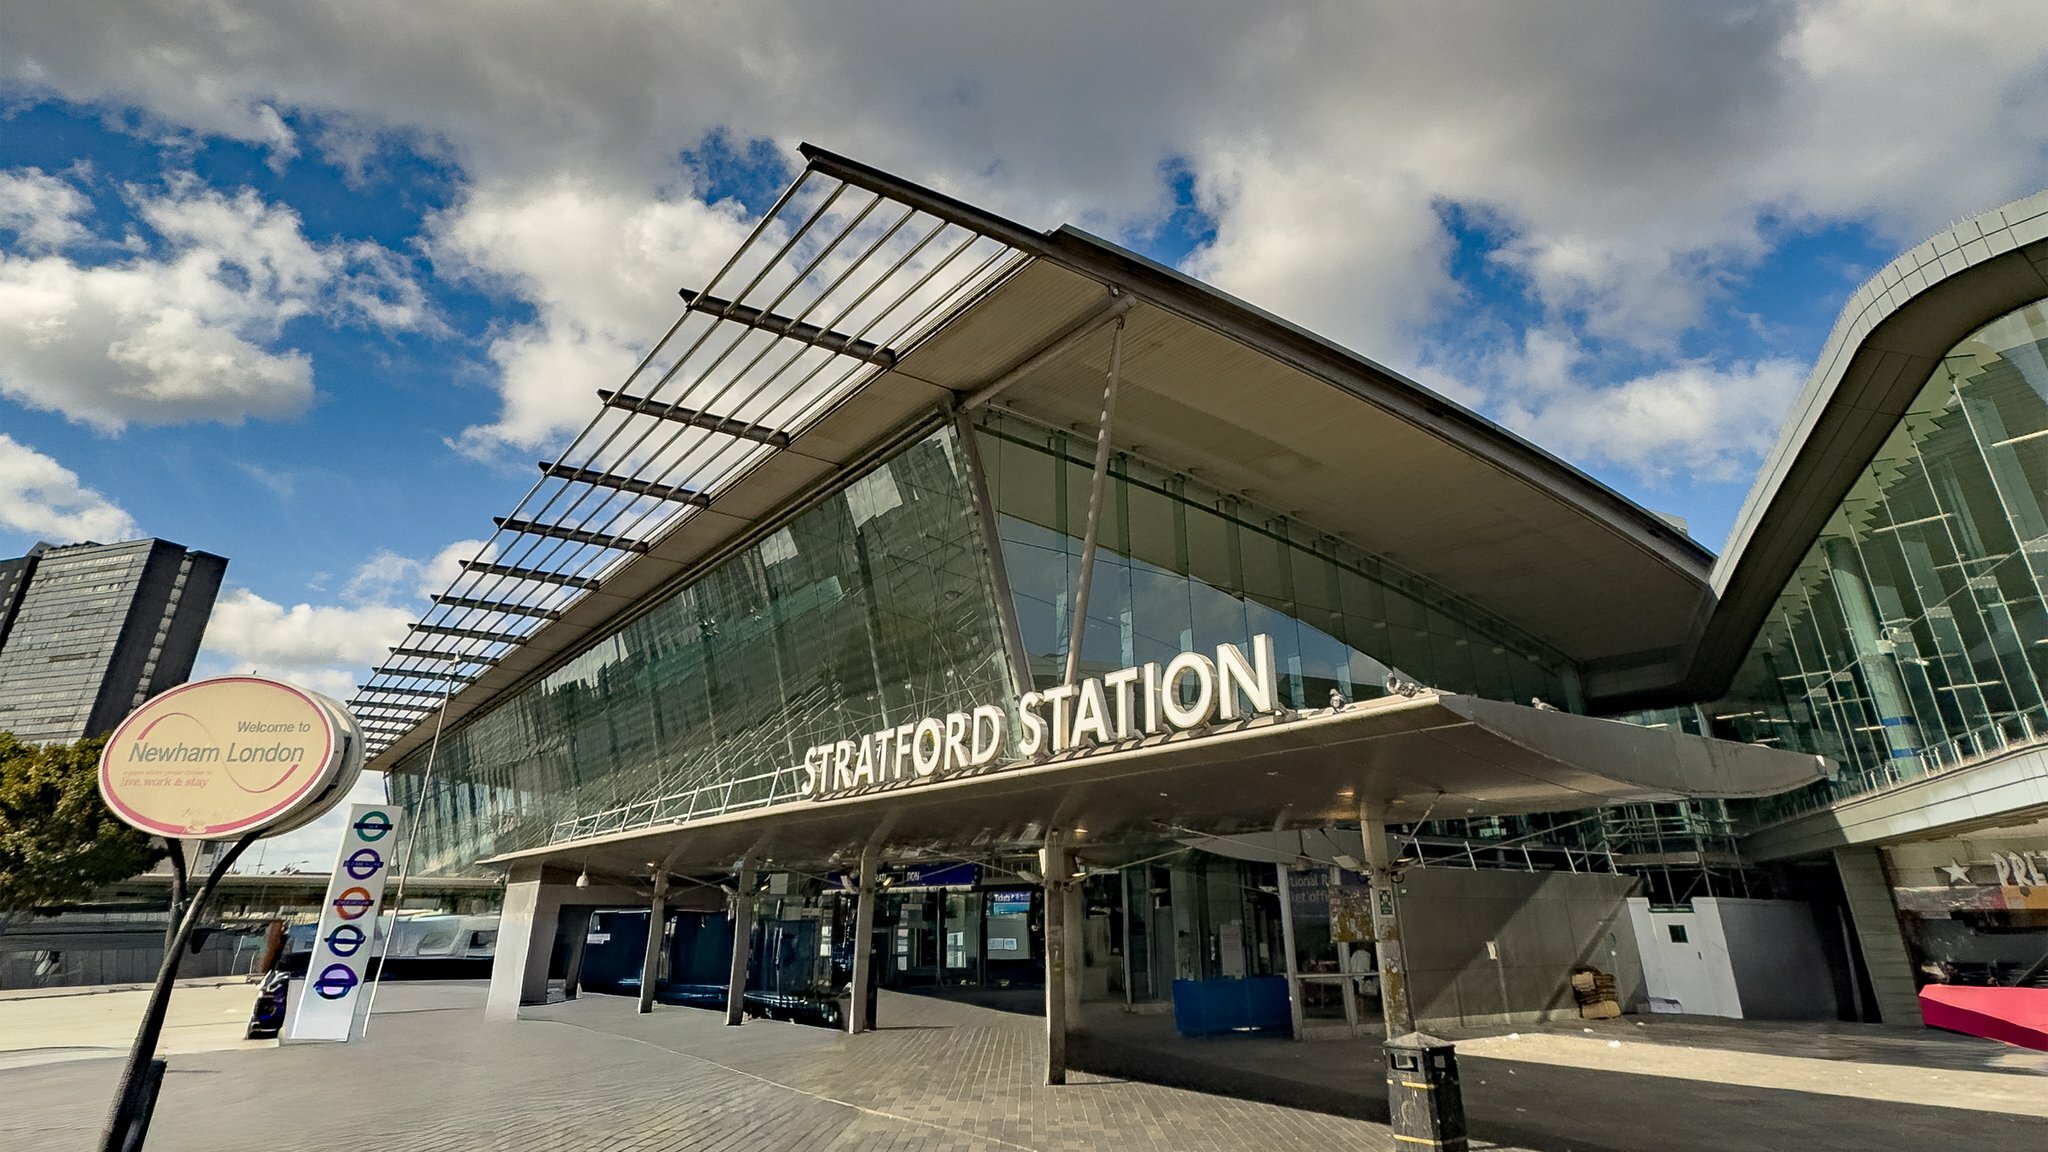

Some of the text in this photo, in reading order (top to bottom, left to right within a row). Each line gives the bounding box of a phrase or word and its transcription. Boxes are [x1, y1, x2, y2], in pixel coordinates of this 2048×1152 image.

[801, 633, 1279, 798] STRATFORD STATION
[237, 721, 310, 733] Welcome to
[128, 743, 304, 762] Newham London
[144, 777, 172, 787] work
[174, 778, 183, 787] &
[185, 778, 210, 789] stay
[1990, 850, 2048, 886] PRE
